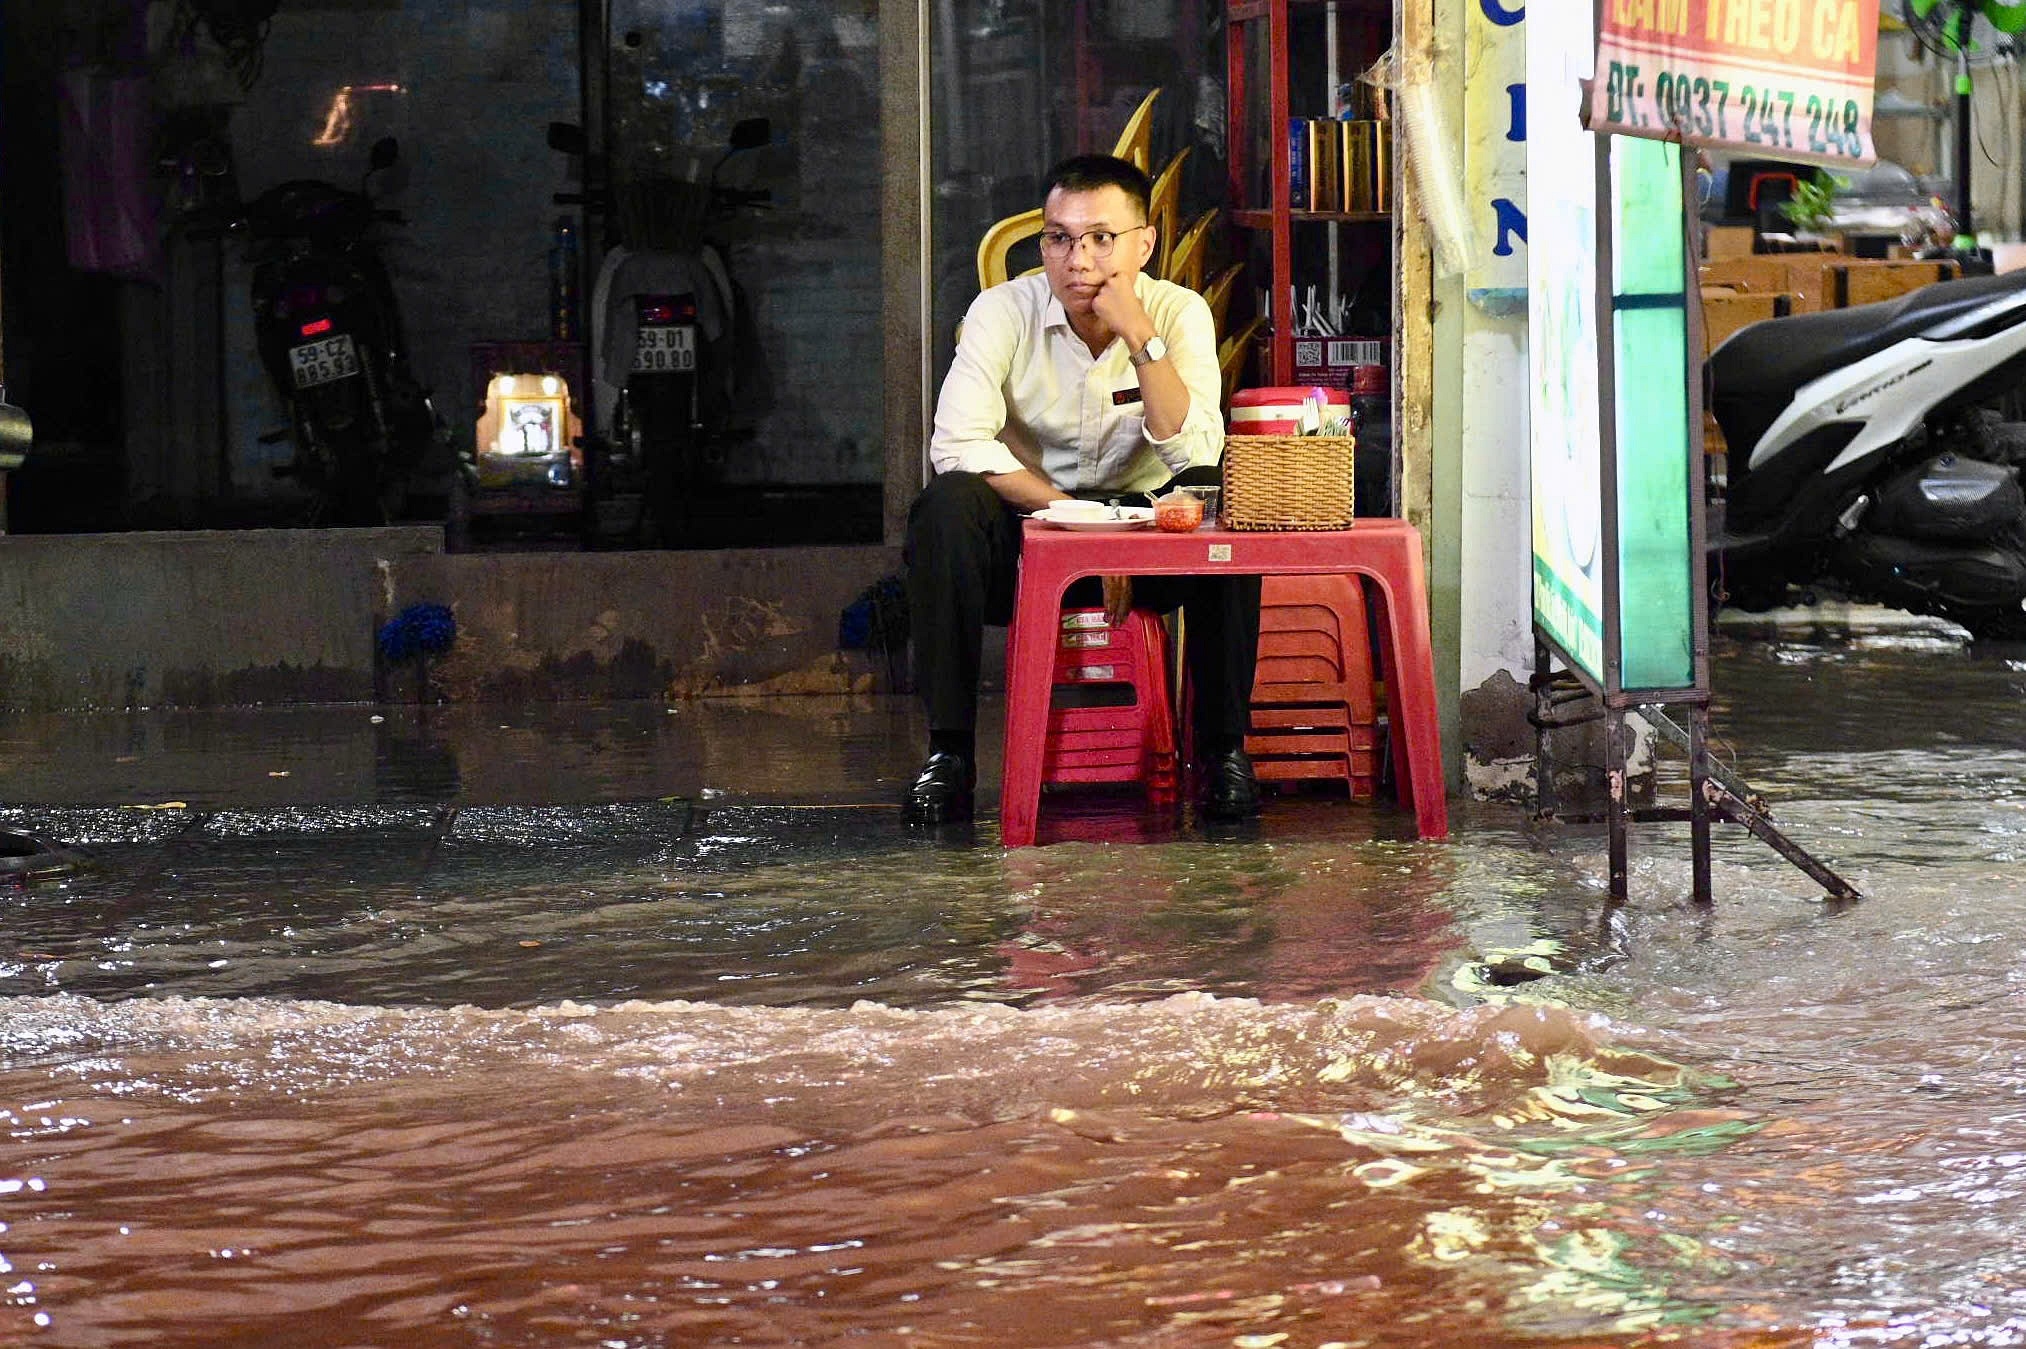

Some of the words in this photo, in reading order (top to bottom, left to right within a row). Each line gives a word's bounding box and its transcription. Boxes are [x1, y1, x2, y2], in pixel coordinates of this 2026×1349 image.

[1705, 0, 1800, 56] THEO
[1656, 71, 1730, 138] 0937
[1740, 85, 1795, 149] 247
[1806, 94, 1863, 159] 248
